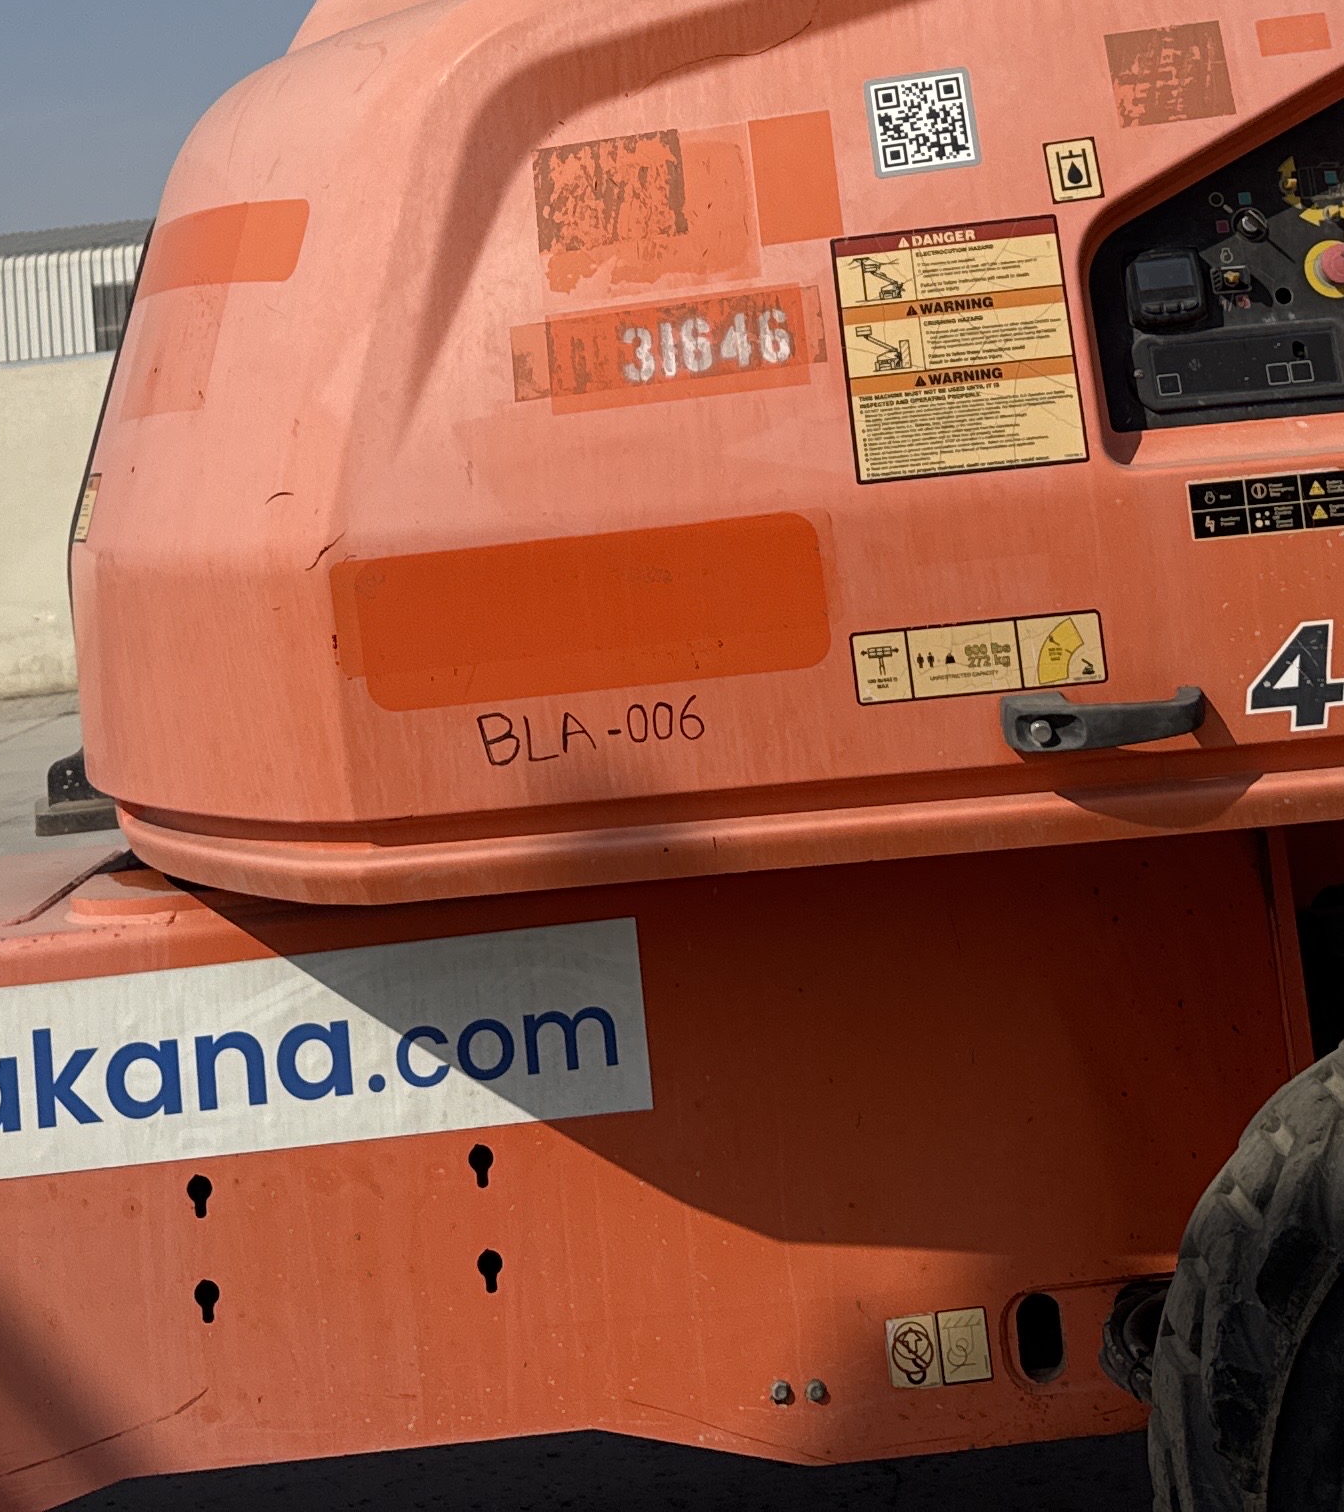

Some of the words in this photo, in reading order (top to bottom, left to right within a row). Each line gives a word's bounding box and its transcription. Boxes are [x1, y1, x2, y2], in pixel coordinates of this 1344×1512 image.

[911, 229, 976, 248] DANGER
[919, 296, 994, 315] WARNING
[619, 307, 792, 383] 31646
[928, 368, 1003, 386] WARNING
[476, 694, 706, 766] BLA-006
